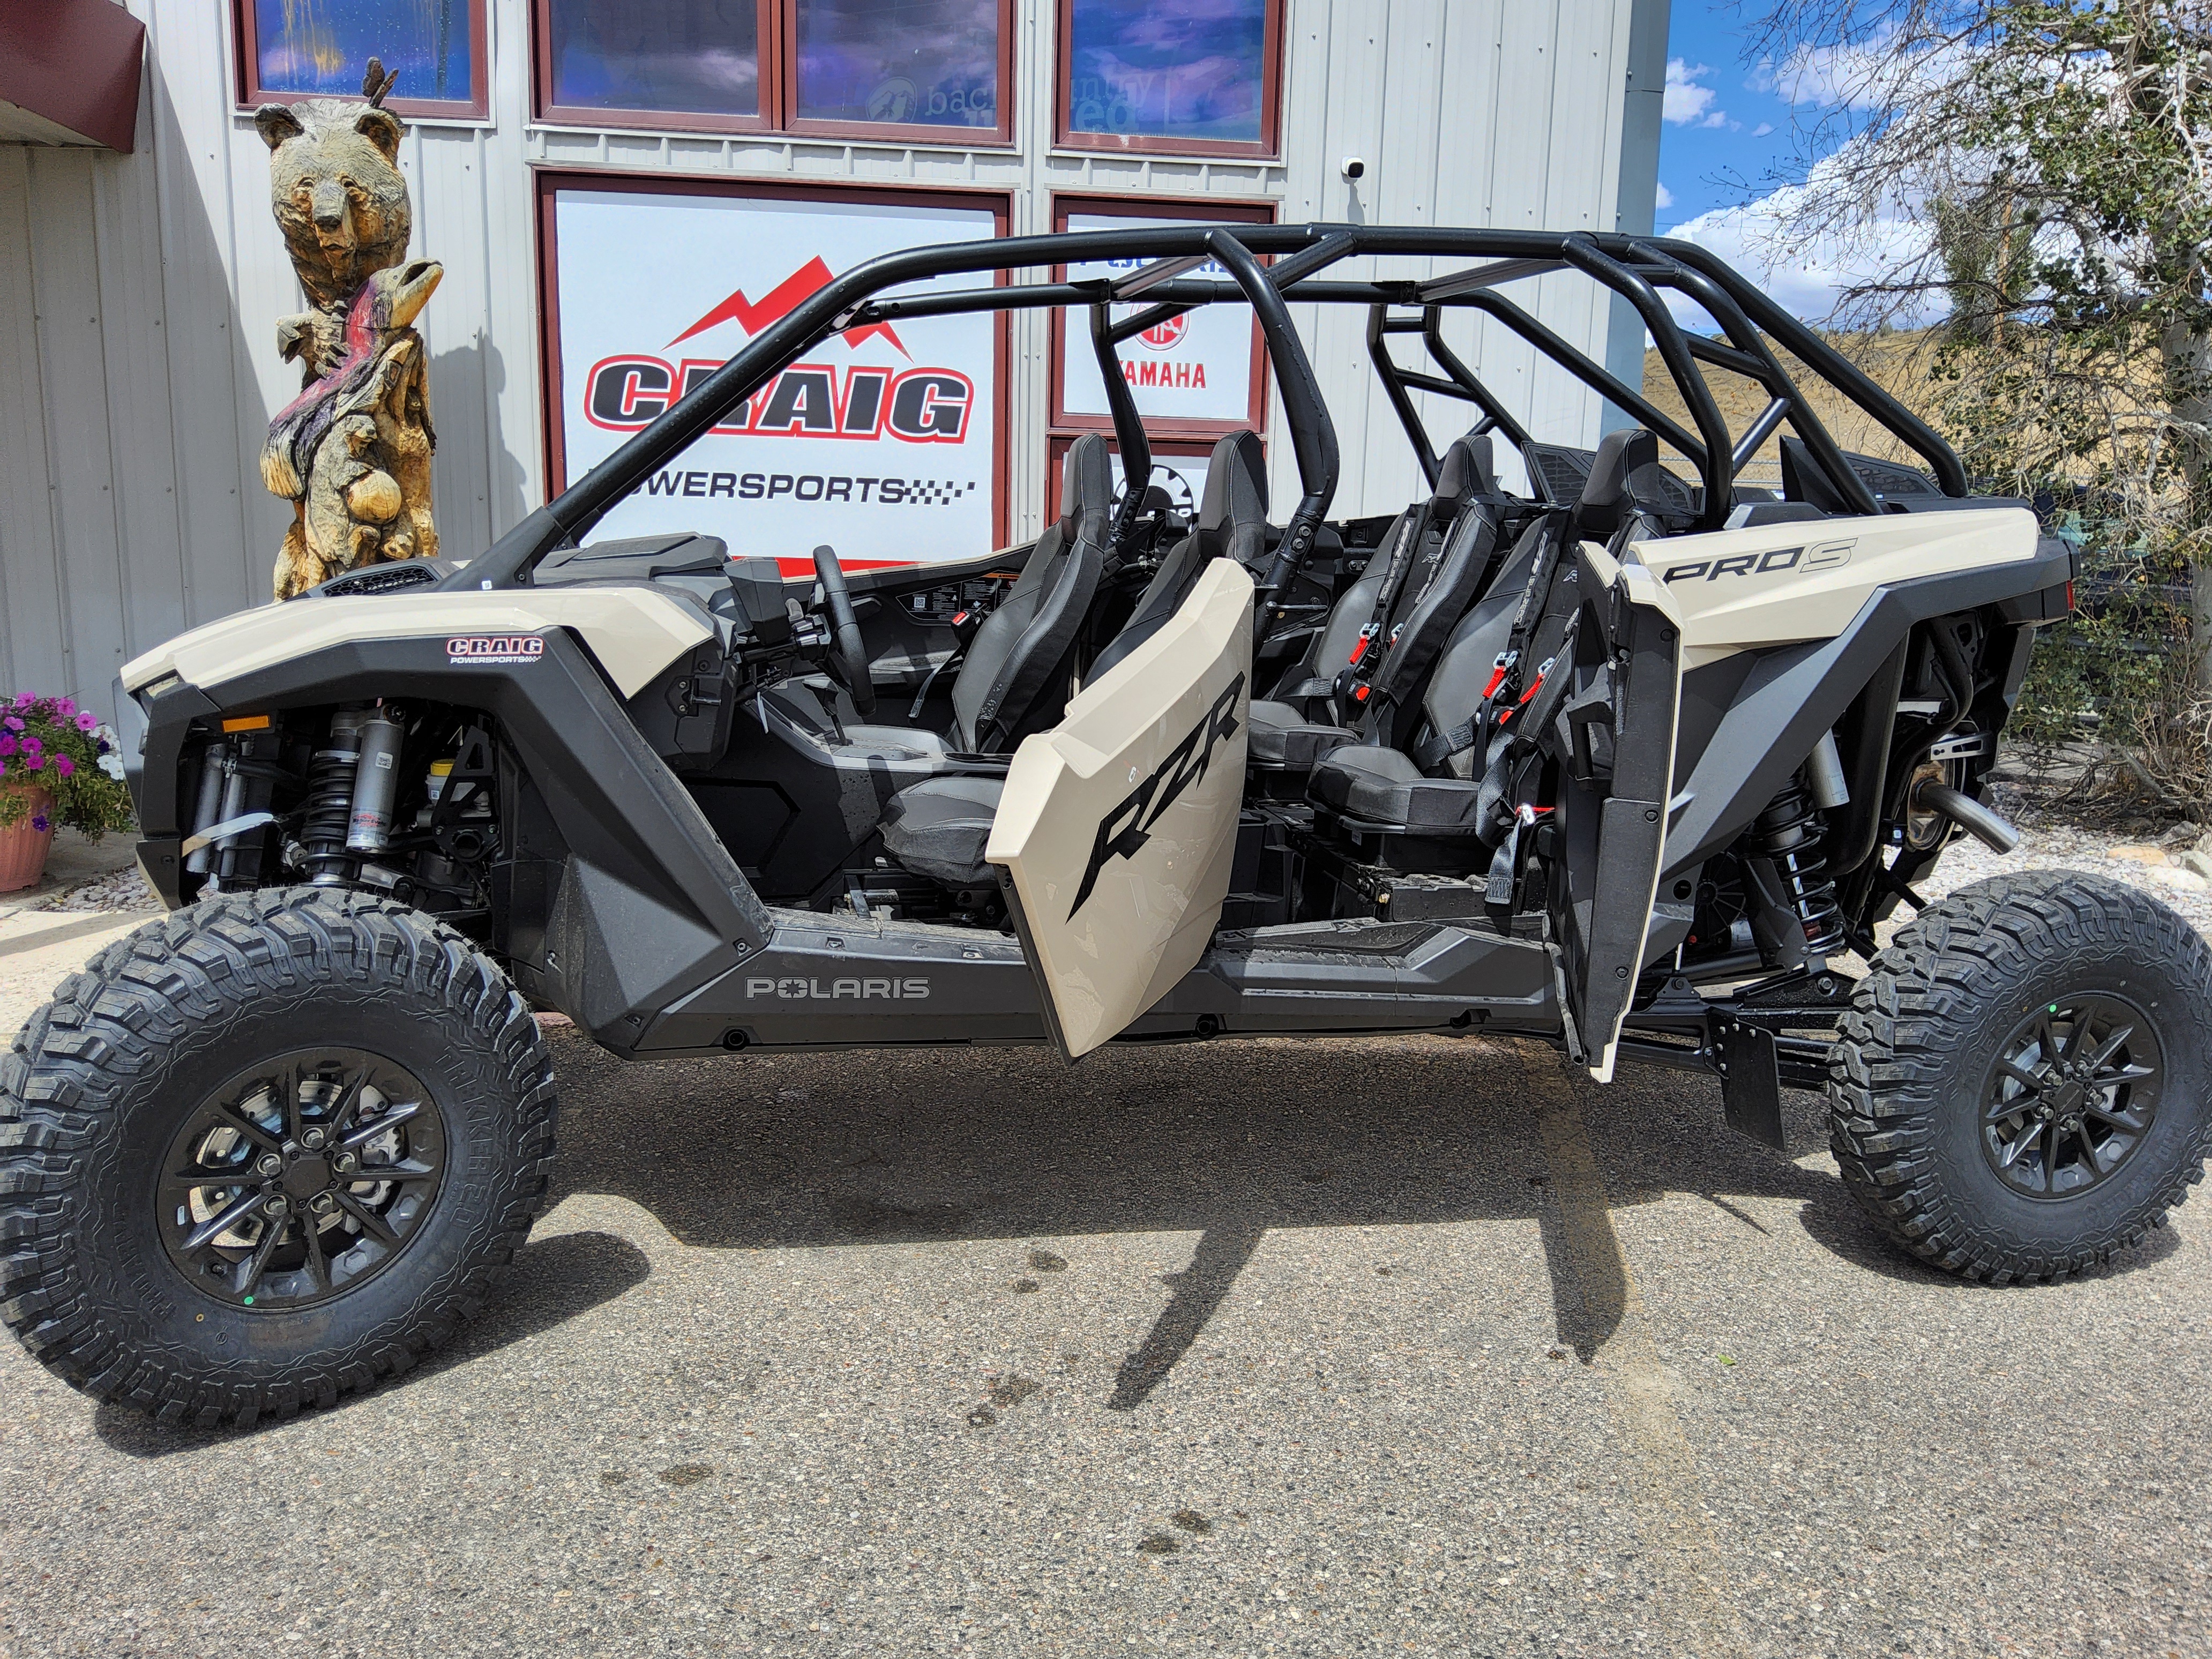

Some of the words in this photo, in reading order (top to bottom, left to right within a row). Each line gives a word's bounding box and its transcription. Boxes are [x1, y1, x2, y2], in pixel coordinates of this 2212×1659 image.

[1119, 360, 1206, 388] AMAHA
[588, 468, 905, 504] WERSPORTS
[445, 636, 544, 656] CRAIG
[450, 655, 525, 664] POWERSPORTS
[1065, 670, 1245, 925] RZR
[745, 977, 932, 999] POLARIS
